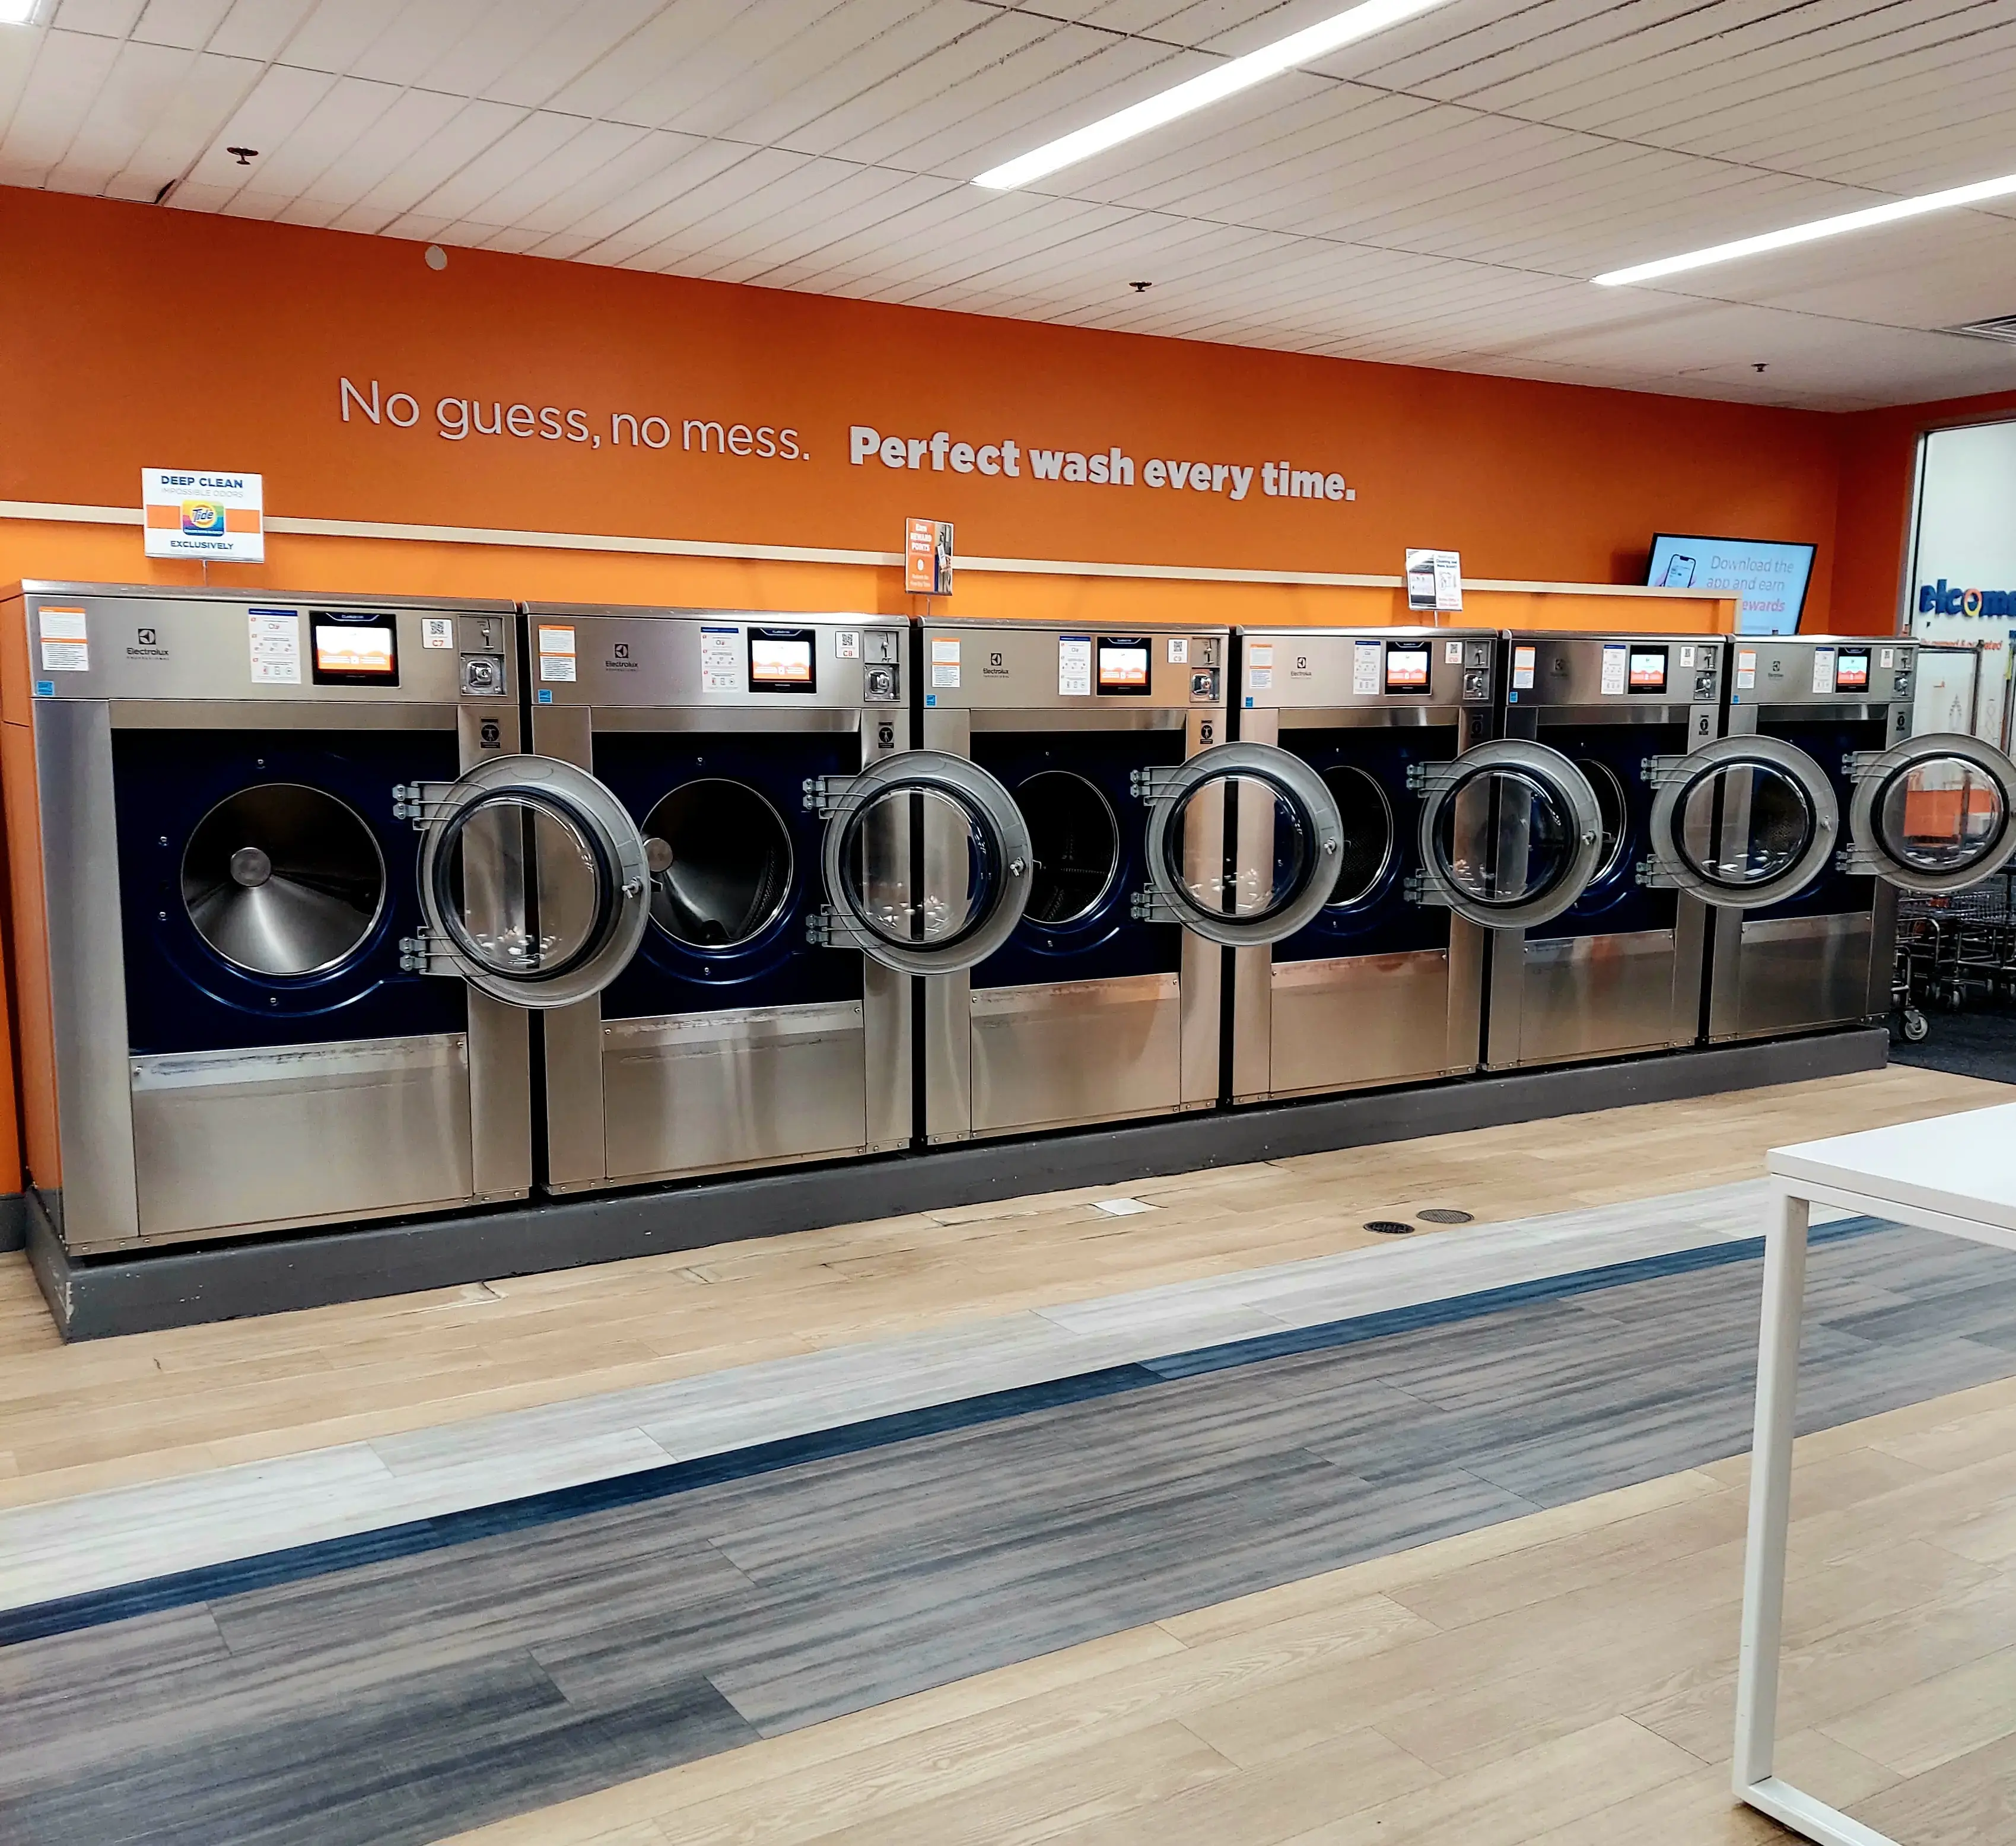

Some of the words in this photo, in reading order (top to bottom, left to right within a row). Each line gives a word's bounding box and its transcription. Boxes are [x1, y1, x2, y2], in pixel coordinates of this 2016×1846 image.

[339, 377, 420, 428] No
[436, 396, 600, 450] guess,
[611, 412, 671, 449] no
[682, 419, 810, 460] mess.
[849, 425, 1020, 478] Perfect
[1028, 446, 1134, 487] wash
[1143, 461, 1254, 500] every
[1261, 461, 1356, 501] time.
[161, 475, 195, 486] DEEP
[199, 478, 244, 488] CLEAN
[161, 487, 211, 497] IMPOSSIBLE
[192, 509, 214, 522] Tide
[170, 541, 234, 550] EXCLUSIVELY
[1710, 555, 1772, 572] Download
[1775, 560, 1794, 574] the
[1706, 577, 1730, 589] app
[1732, 577, 1757, 590] and
[1759, 580, 1785, 592] earn
[1742, 598, 1786, 612] ewards
[126, 647, 169, 656] Electrolux
